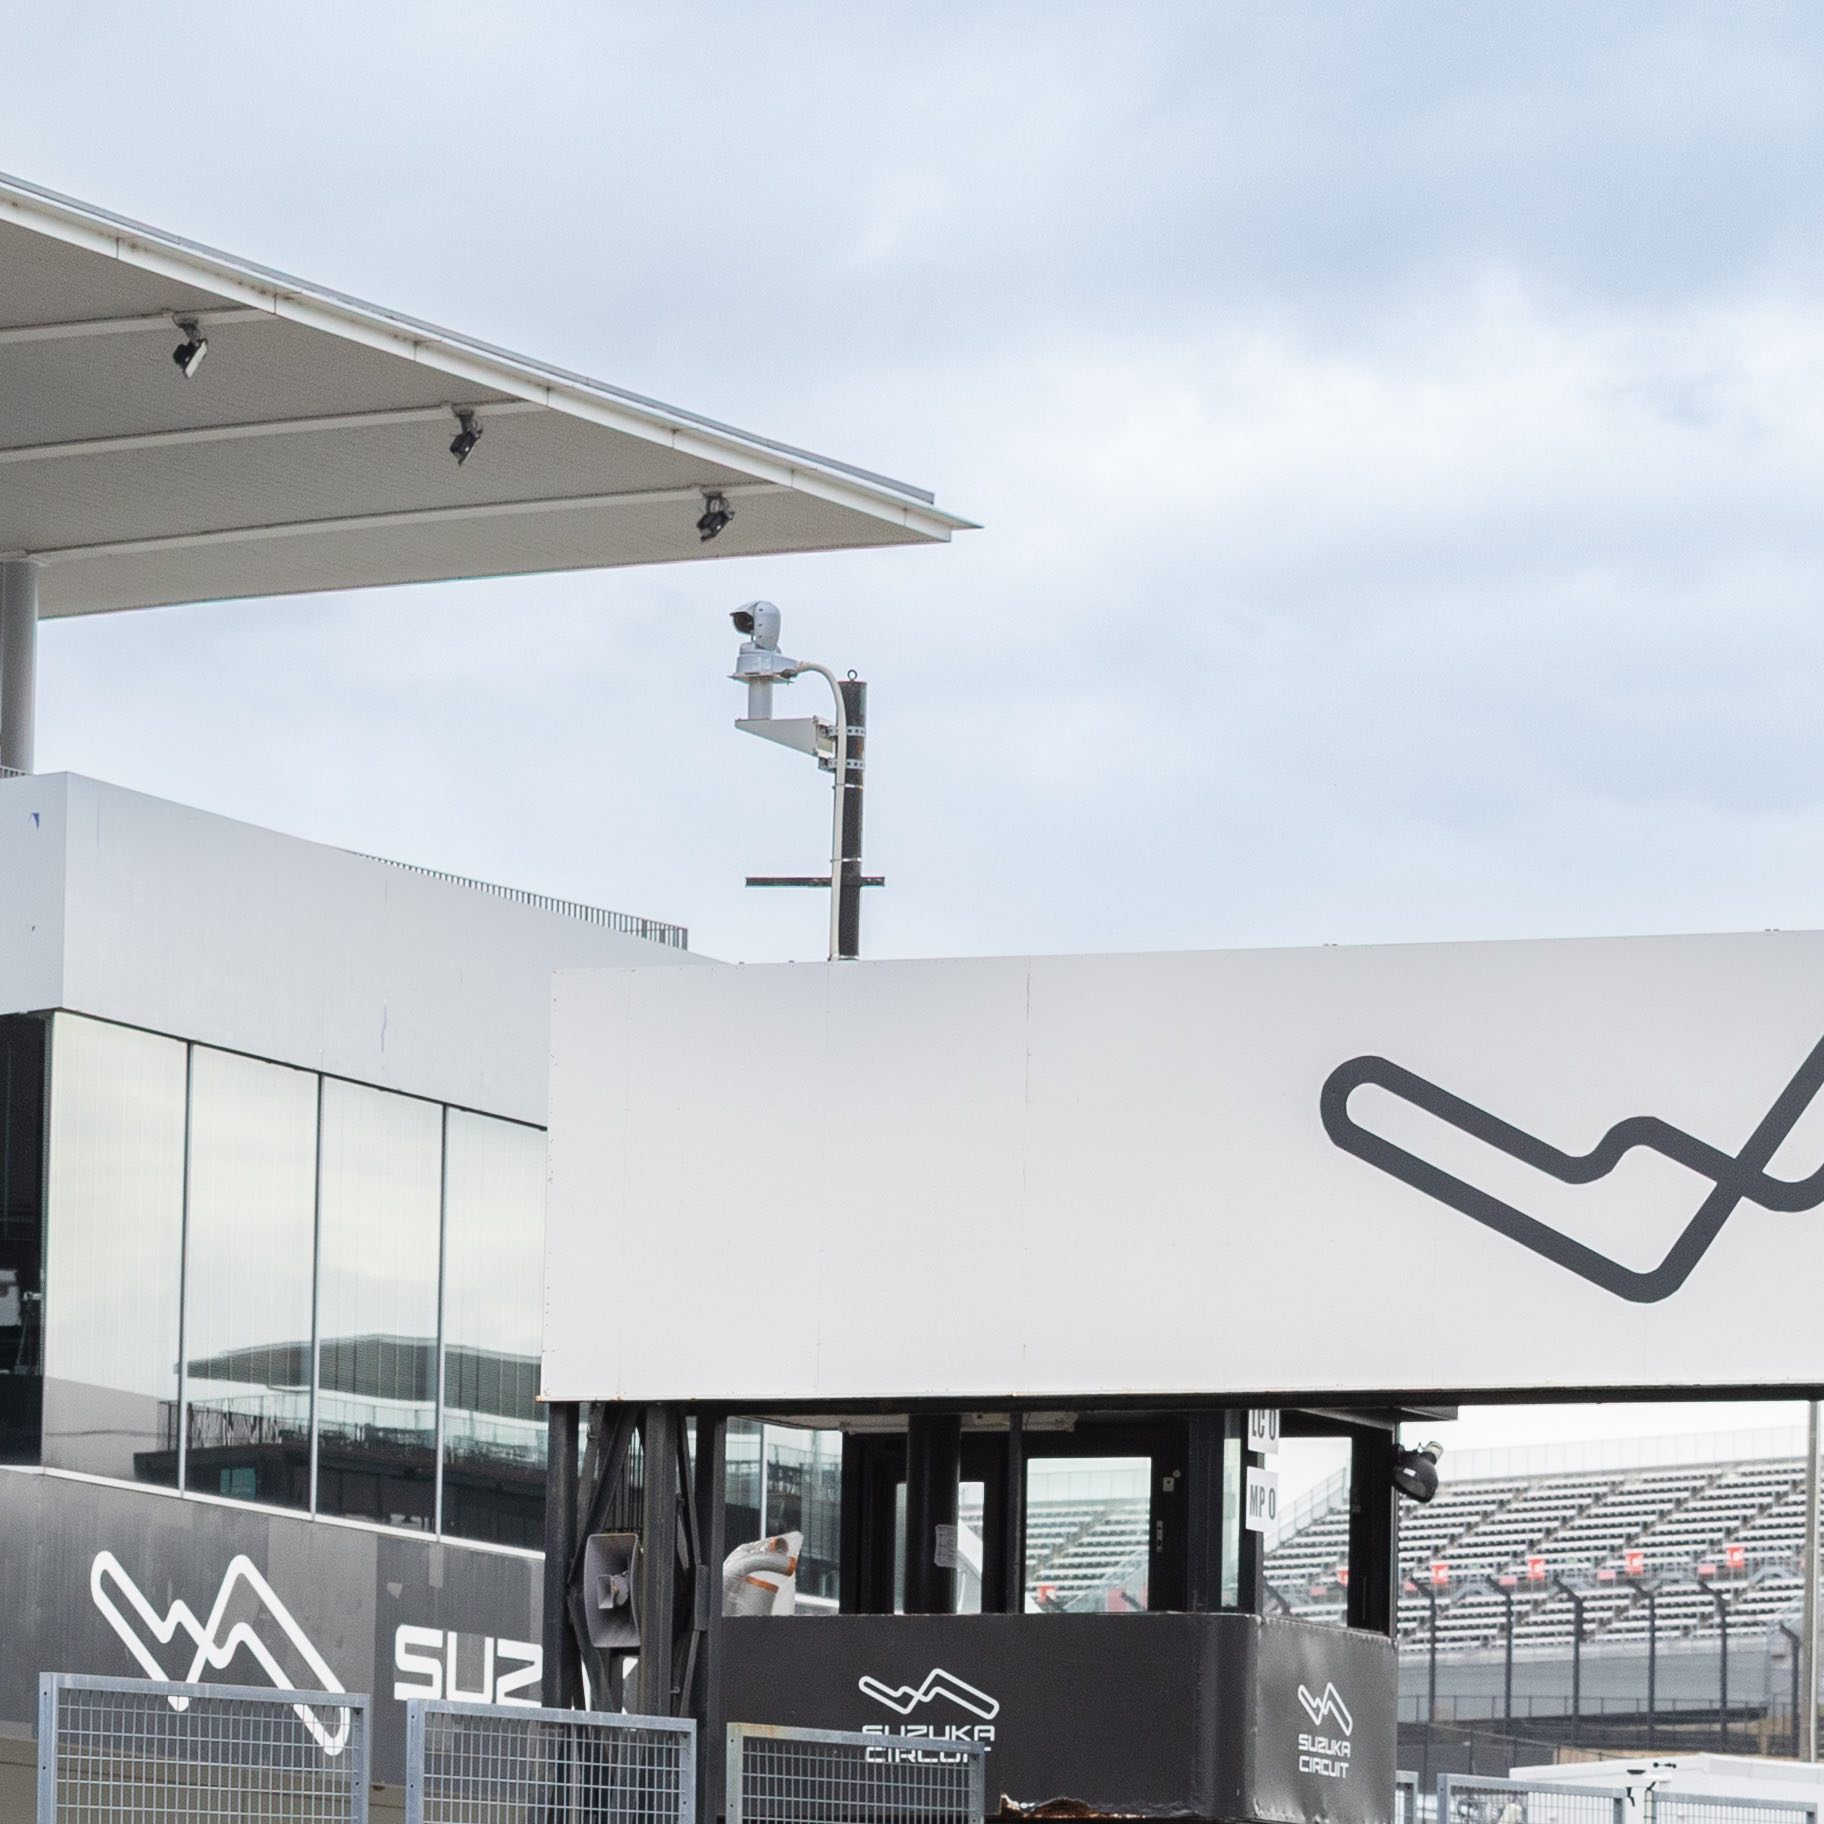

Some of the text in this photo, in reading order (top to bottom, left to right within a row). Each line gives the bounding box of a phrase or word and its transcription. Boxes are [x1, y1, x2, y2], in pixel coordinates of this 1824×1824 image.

[394, 1624, 544, 1708] SUZ
[865, 1746, 992, 1764] CIRCUI
[1298, 1733, 1351, 1758] SUZUKA
[1299, 1755, 1349, 1779] CIRCUIT
